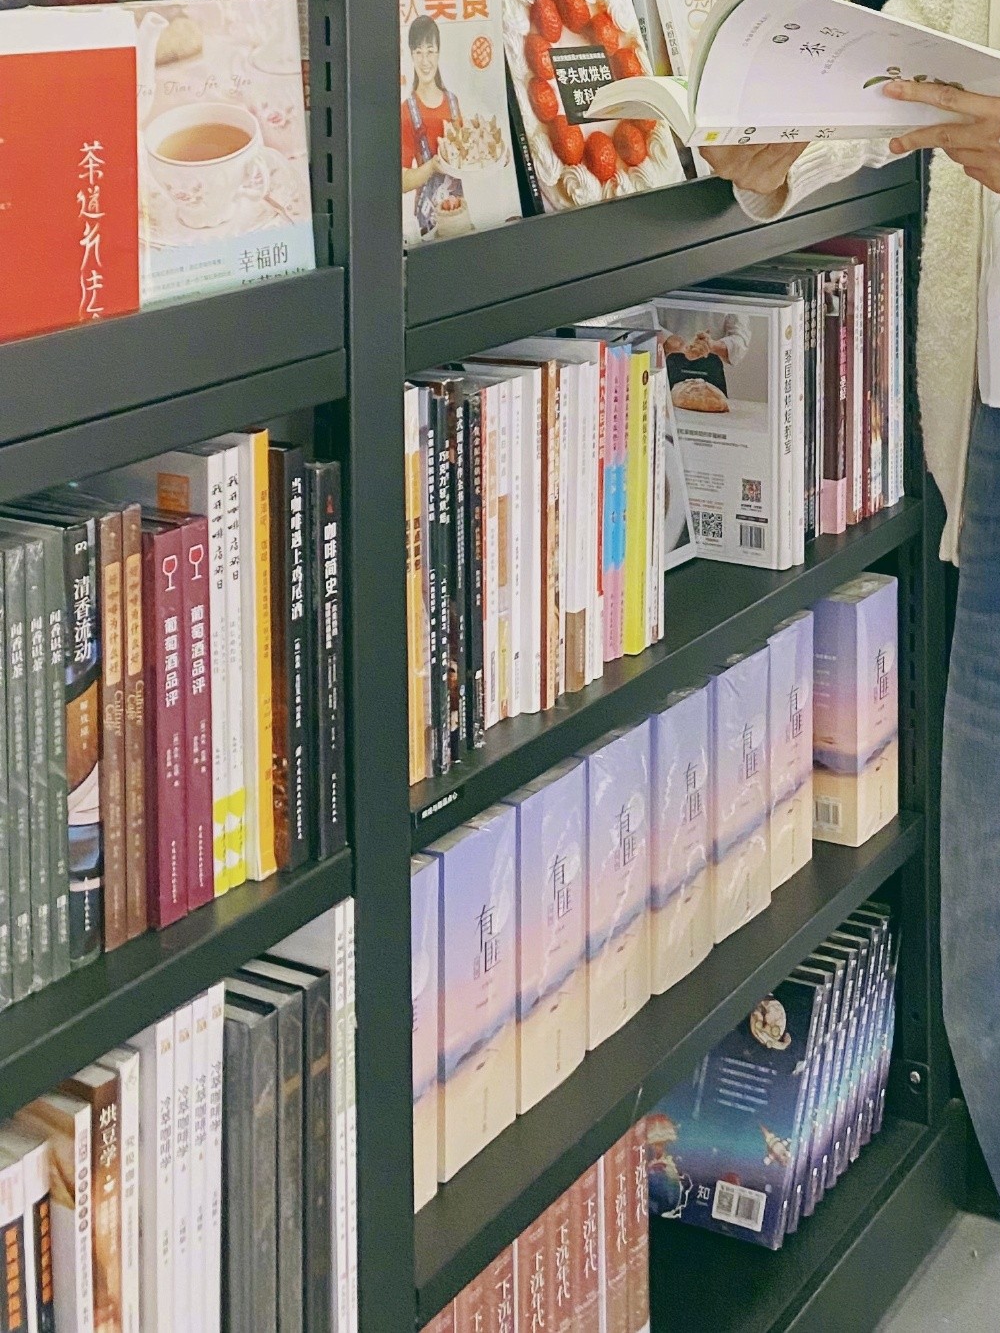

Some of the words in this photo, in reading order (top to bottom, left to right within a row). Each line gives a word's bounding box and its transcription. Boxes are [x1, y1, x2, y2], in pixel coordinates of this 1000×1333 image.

[556, 65, 612, 86] 零失败烘焙
[572, 87, 604, 107] 教科
[238, 242, 288, 273] 幸福的
[290, 477, 303, 621] 当咖啡遇上鸡尾酒
[324, 522, 338, 598] 咖啡简史
[74, 575, 92, 662] 清香流动
[191, 604, 206, 696] 葡萄酒品评
[164, 616, 179, 708] 葡萄酒品评
[875, 648, 890, 700] 有匪
[788, 684, 803, 740] 有匪
[739, 722, 759, 780] 有匪
[683, 761, 703, 822] 有匪
[617, 804, 638, 867] 有匪
[549, 854, 574, 919] 有匪
[473, 904, 503, 974] 有匪
[99, 1103, 117, 1167] 烘豆学
